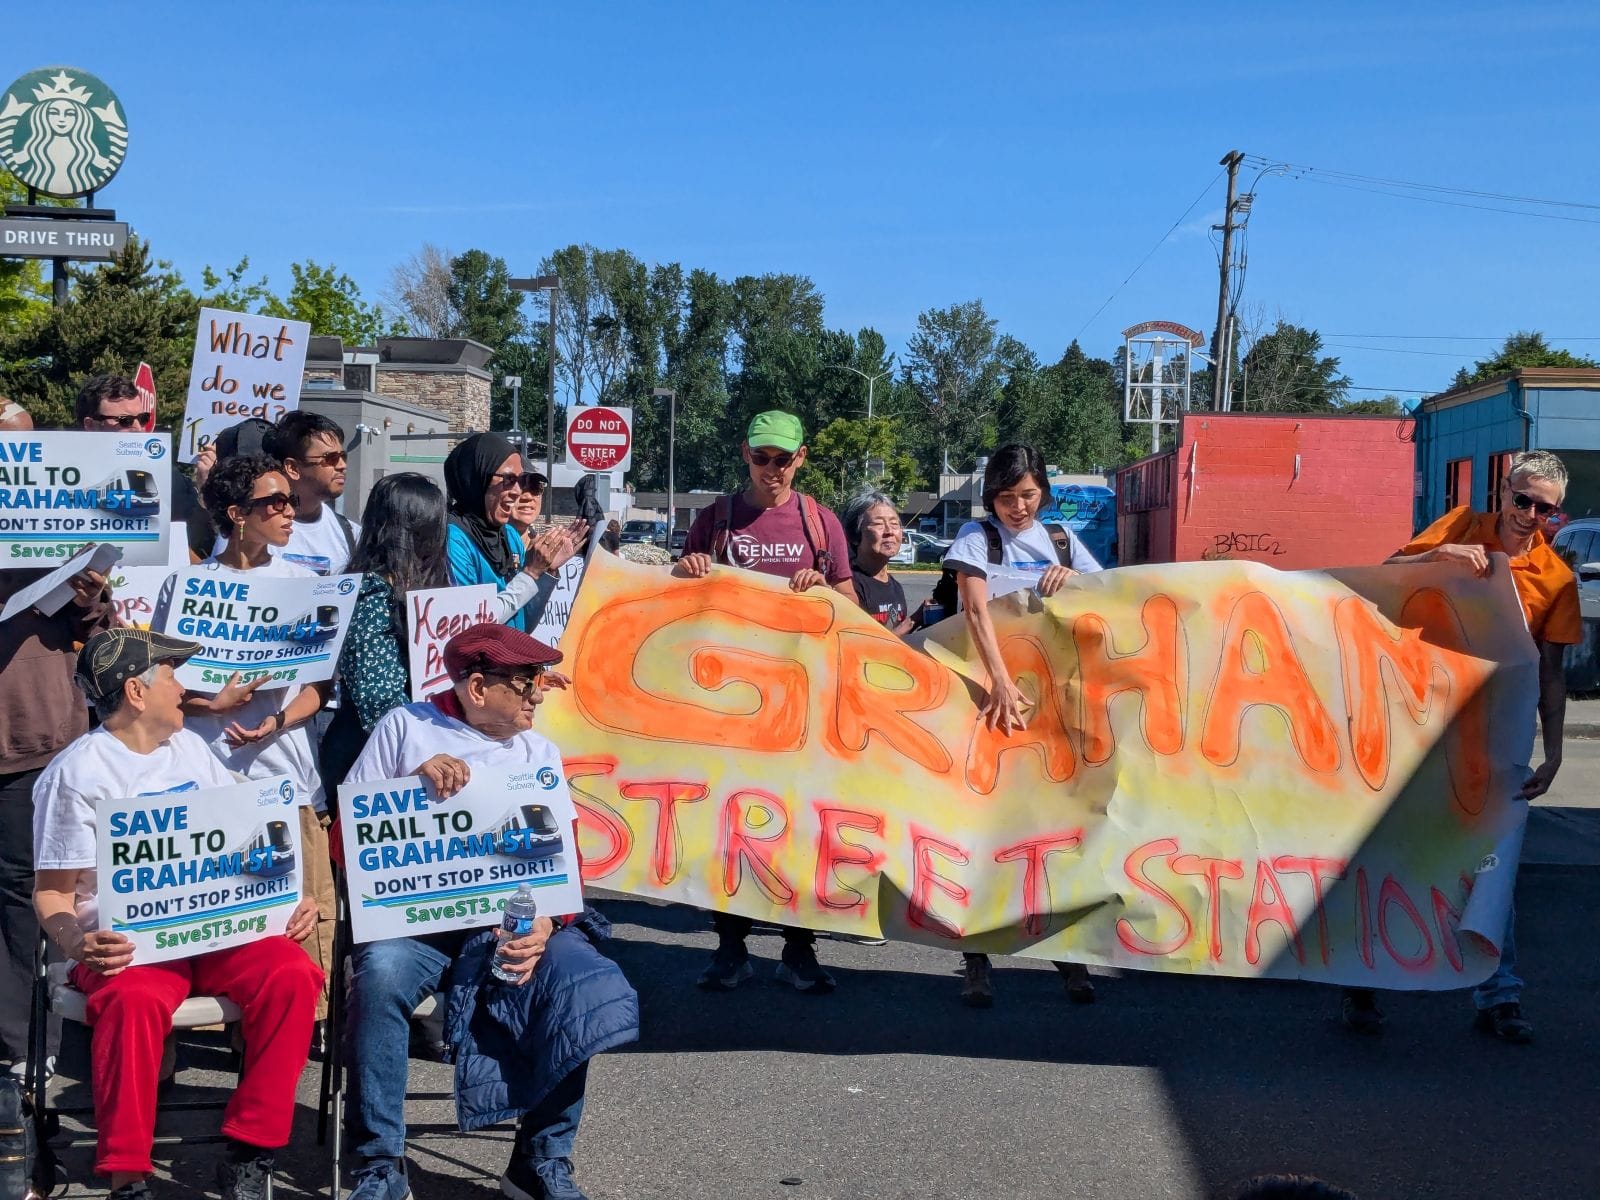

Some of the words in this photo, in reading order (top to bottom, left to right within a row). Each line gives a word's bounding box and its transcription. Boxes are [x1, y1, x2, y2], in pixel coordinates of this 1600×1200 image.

[5, 230, 58, 245] DRIVE
[65, 231, 114, 246] THRU
[211, 319, 293, 361] What
[201, 365, 239, 394] do
[252, 382, 287, 400] we
[137, 386, 154, 414] TOP
[577, 419, 593, 429] DO
[600, 420, 621, 431] NOT
[0, 442, 43, 463] AVE
[580, 447, 616, 459] ENTER
[0, 467, 37, 486] AIL
[45, 467, 81, 486] TO
[0, 489, 98, 510] RAHAM
[106, 489, 136, 510] ST
[0, 518, 39, 531] ON'T
[43, 518, 86, 531] STOP
[90, 518, 149, 531] SHORT!
[738, 543, 804, 557] RENEW
[185, 577, 249, 601] SAVE
[182, 599, 238, 621] RAIL
[247, 606, 278, 623] TO
[177, 617, 289, 643] GRAHAM
[294, 621, 321, 640] ST
[197, 646, 233, 660] ON'T
[236, 649, 274, 661] STOP
[276, 643, 325, 659] SHORT!
[572, 580, 1491, 816] GRAHAM
[506, 781, 536, 791] Subway
[508, 772, 535, 782] Seattle
[352, 787, 429, 819] SAVE
[110, 806, 188, 837] SAVE
[356, 817, 425, 845] RAIL
[433, 810, 473, 835] TO
[112, 836, 181, 866] RAIL
[190, 829, 226, 855] TO
[359, 832, 494, 872] GRAHAM
[502, 827, 535, 853] ST
[562, 755, 1083, 940] STREET
[112, 852, 242, 893] GRAHAM
[249, 845, 276, 873] ST
[375, 874, 433, 896] DON'T
[438, 868, 484, 887] STOP
[489, 859, 554, 880] SHORT!
[126, 897, 184, 919] DON'T
[189, 888, 230, 910] STOP
[235, 876, 289, 899] SHORT!
[405, 897, 508, 923] SaveST3.o
[155, 914, 267, 949] SaveST3.org
